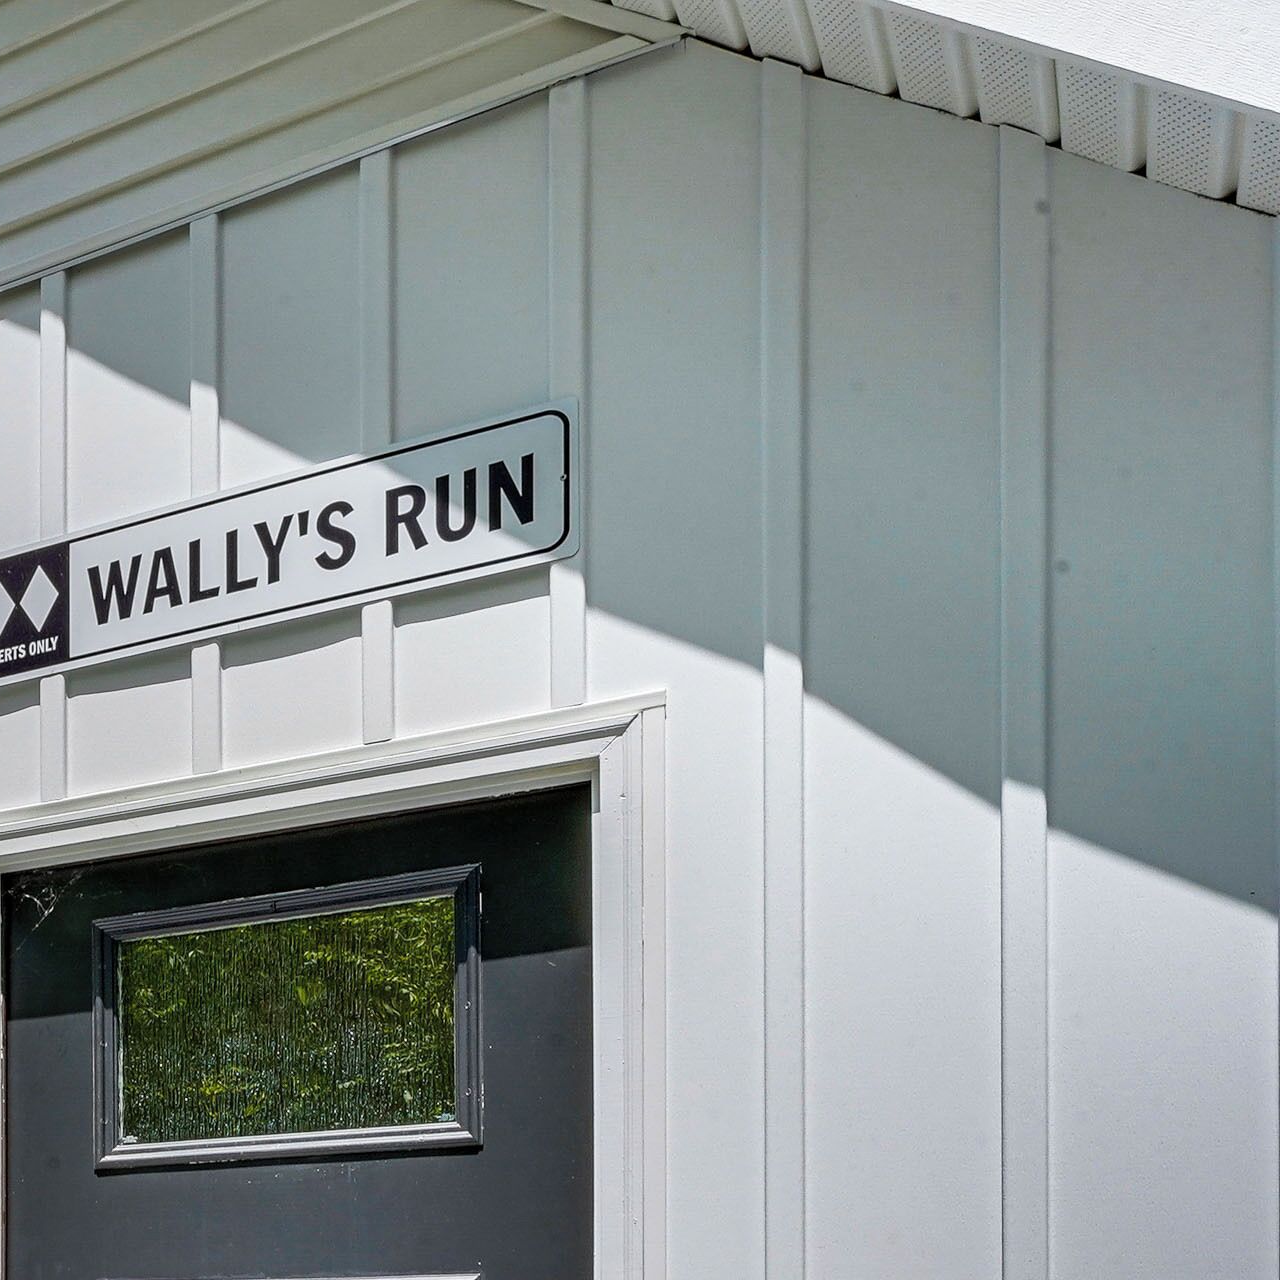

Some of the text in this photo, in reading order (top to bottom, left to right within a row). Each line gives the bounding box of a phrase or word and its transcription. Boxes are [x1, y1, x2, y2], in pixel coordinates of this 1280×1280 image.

[86, 452, 536, 625] WALLY'S RUN
[28, 635, 59, 656] ONLY
